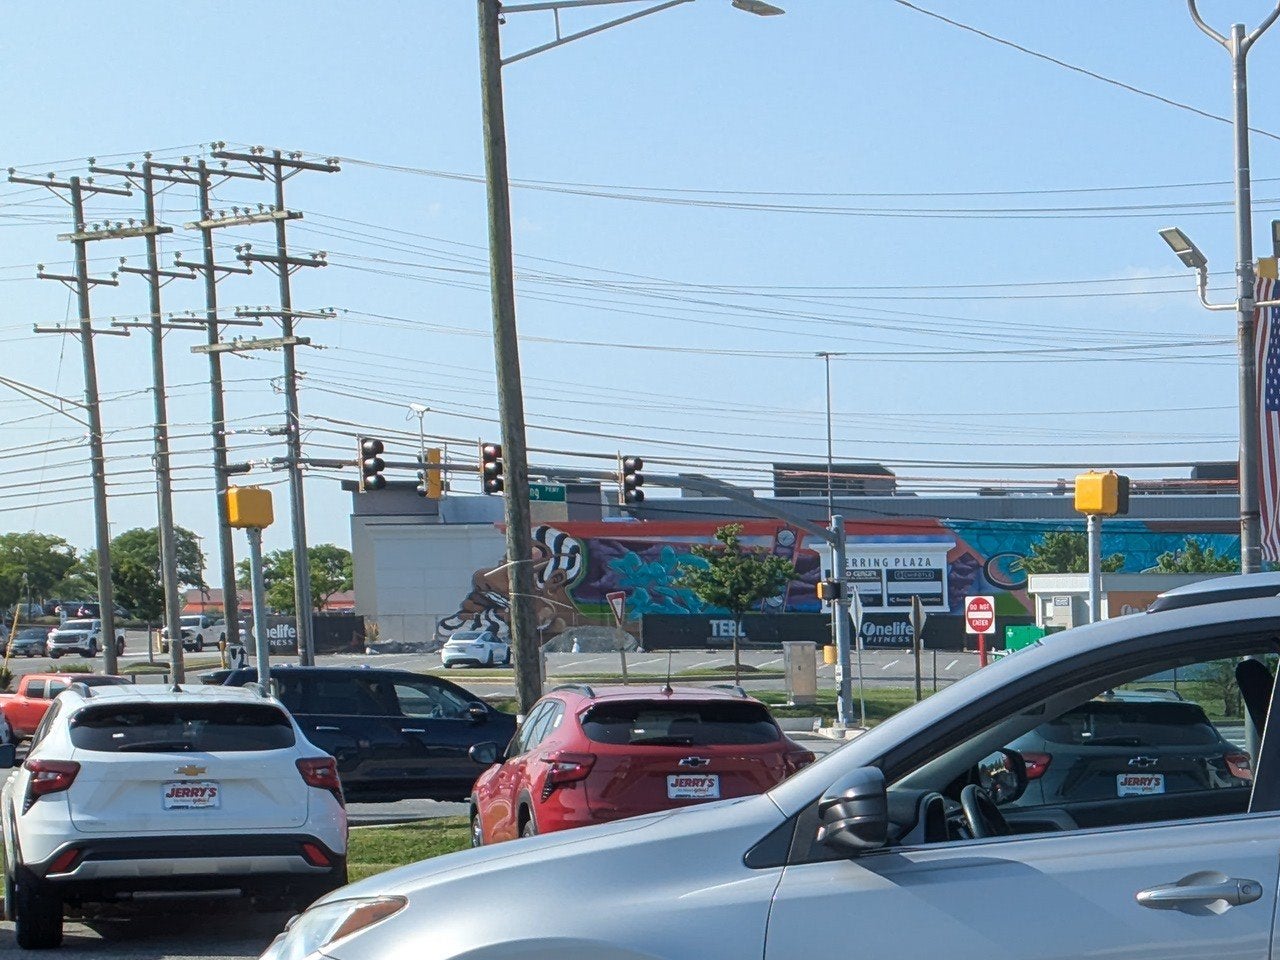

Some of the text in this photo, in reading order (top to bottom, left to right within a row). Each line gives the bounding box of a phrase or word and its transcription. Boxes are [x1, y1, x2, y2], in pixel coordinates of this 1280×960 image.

[845, 557, 932, 567] ERRING PLAZA
[862, 621, 914, 636] Onelife
[671, 778, 715, 788] JERRY'S
[1120, 777, 1161, 787] JERRY'S
[166, 787, 217, 799] JERRY'S
